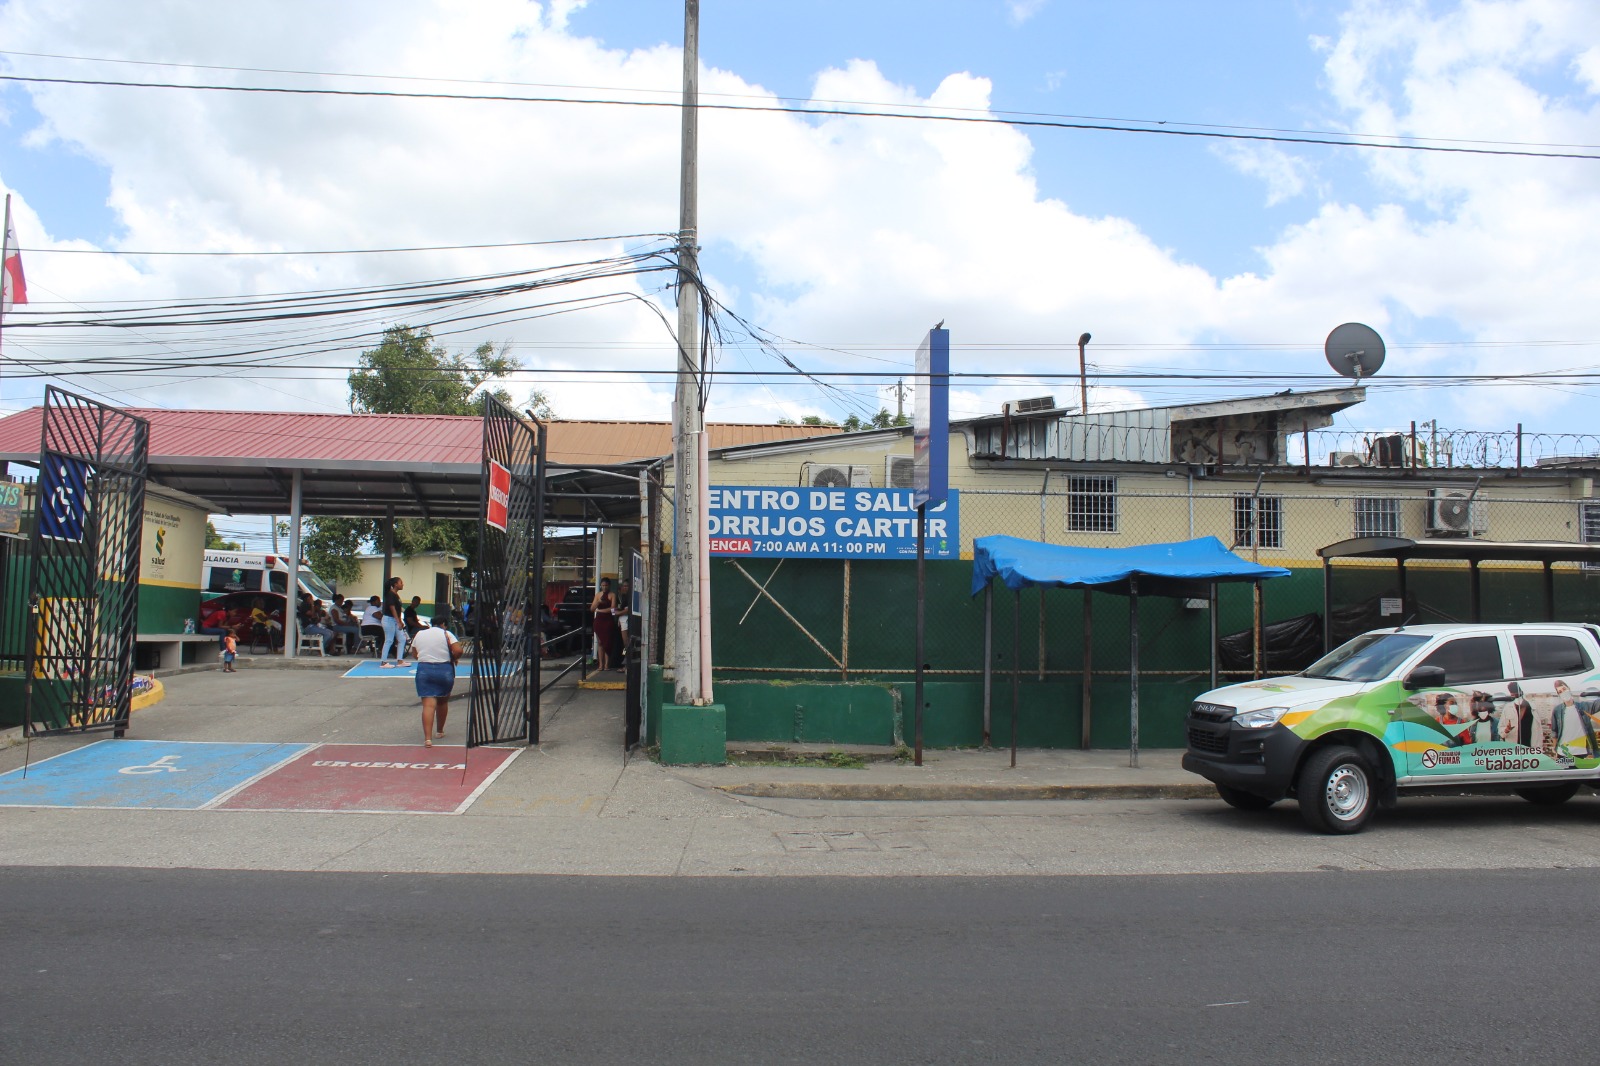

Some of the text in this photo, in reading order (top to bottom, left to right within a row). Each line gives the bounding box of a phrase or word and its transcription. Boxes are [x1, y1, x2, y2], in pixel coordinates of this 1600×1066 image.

[708, 490, 947, 512] ENTRO DE SAL
[708, 515, 948, 538] ORRIJOS CARTER
[709, 540, 752, 551] ENCIA
[753, 541, 783, 552] 7:00
[785, 541, 807, 553] AM
[809, 542, 820, 553] A
[865, 543, 886, 554] PM
[151, 556, 166, 565] salud
[203, 556, 239, 564] ULANCIA
[1471, 746, 1542, 757] Jóvenes libres
[311, 760, 467, 770] URGENCIA
[1438, 756, 1461, 764] FUMAR
[1474, 757, 1540, 771] de tabaco
